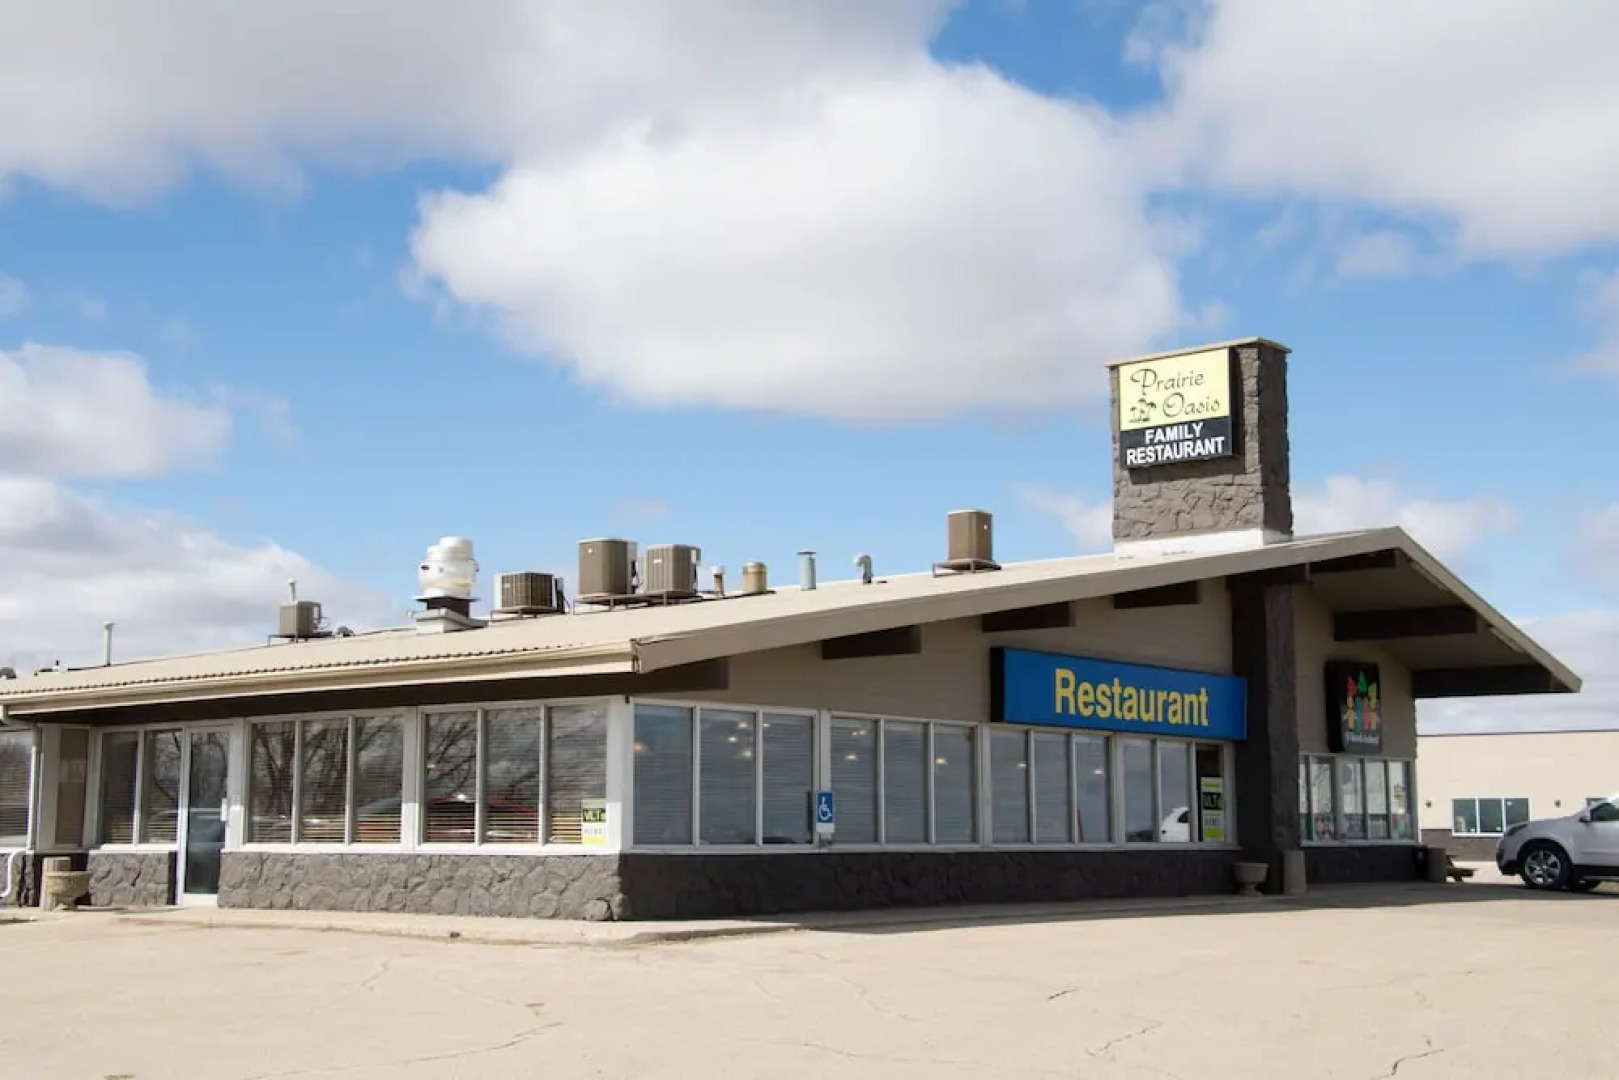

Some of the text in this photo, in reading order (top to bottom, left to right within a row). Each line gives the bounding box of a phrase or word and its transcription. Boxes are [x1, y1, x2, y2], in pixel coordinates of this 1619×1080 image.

[1130, 368, 1204, 396] Prairie
[1162, 392, 1220, 418] Oasis
[1145, 421, 1204, 445] FAMILY
[1126, 436, 1225, 466] RESTAURANT
[1054, 668, 1209, 727] Restaurant
